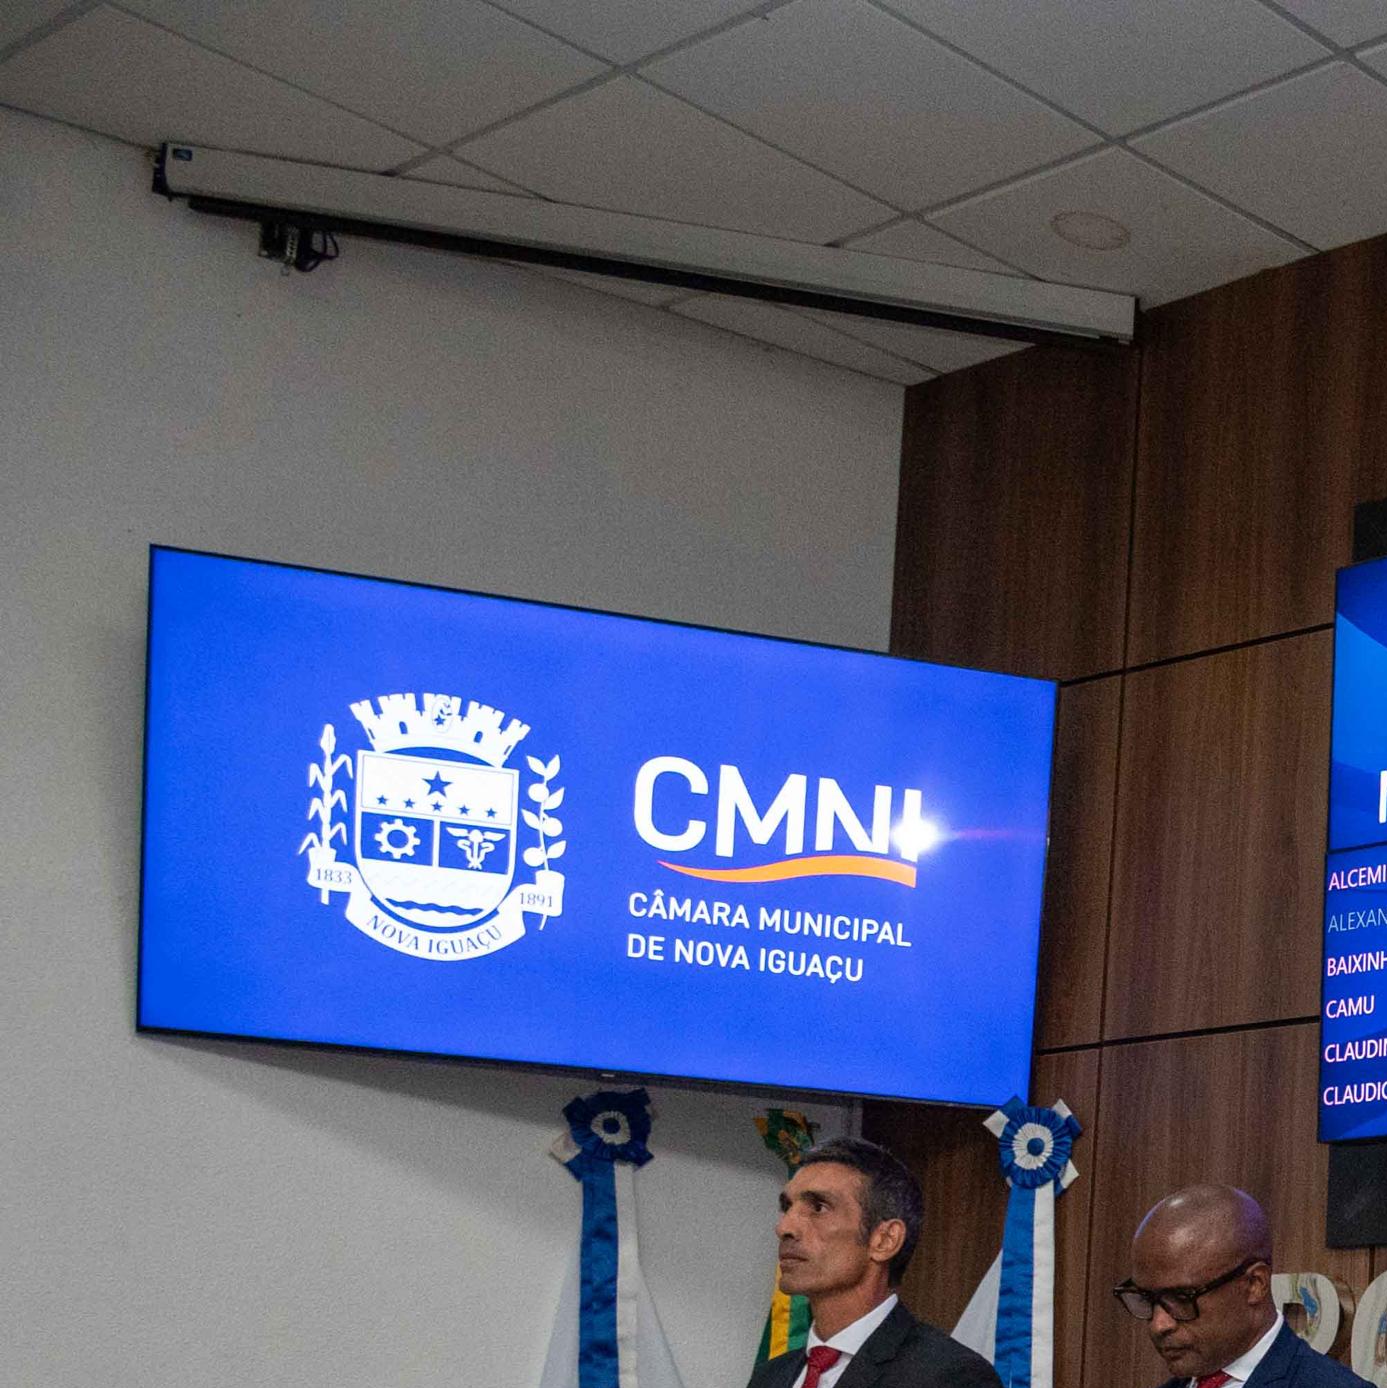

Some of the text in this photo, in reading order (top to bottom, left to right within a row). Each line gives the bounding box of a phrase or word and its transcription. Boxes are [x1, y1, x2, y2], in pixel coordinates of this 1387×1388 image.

[632, 755, 923, 863] CMNI
[316, 868, 352, 884] 1833
[519, 892, 553, 908] 1891
[628, 888, 912, 947] CÂMARA MUNICIPAL
[366, 914, 502, 954] NOVA IGUAÇU
[627, 933, 864, 984] DE NOVA IGUAÇU
[1325, 994, 1375, 1019] CAMU
